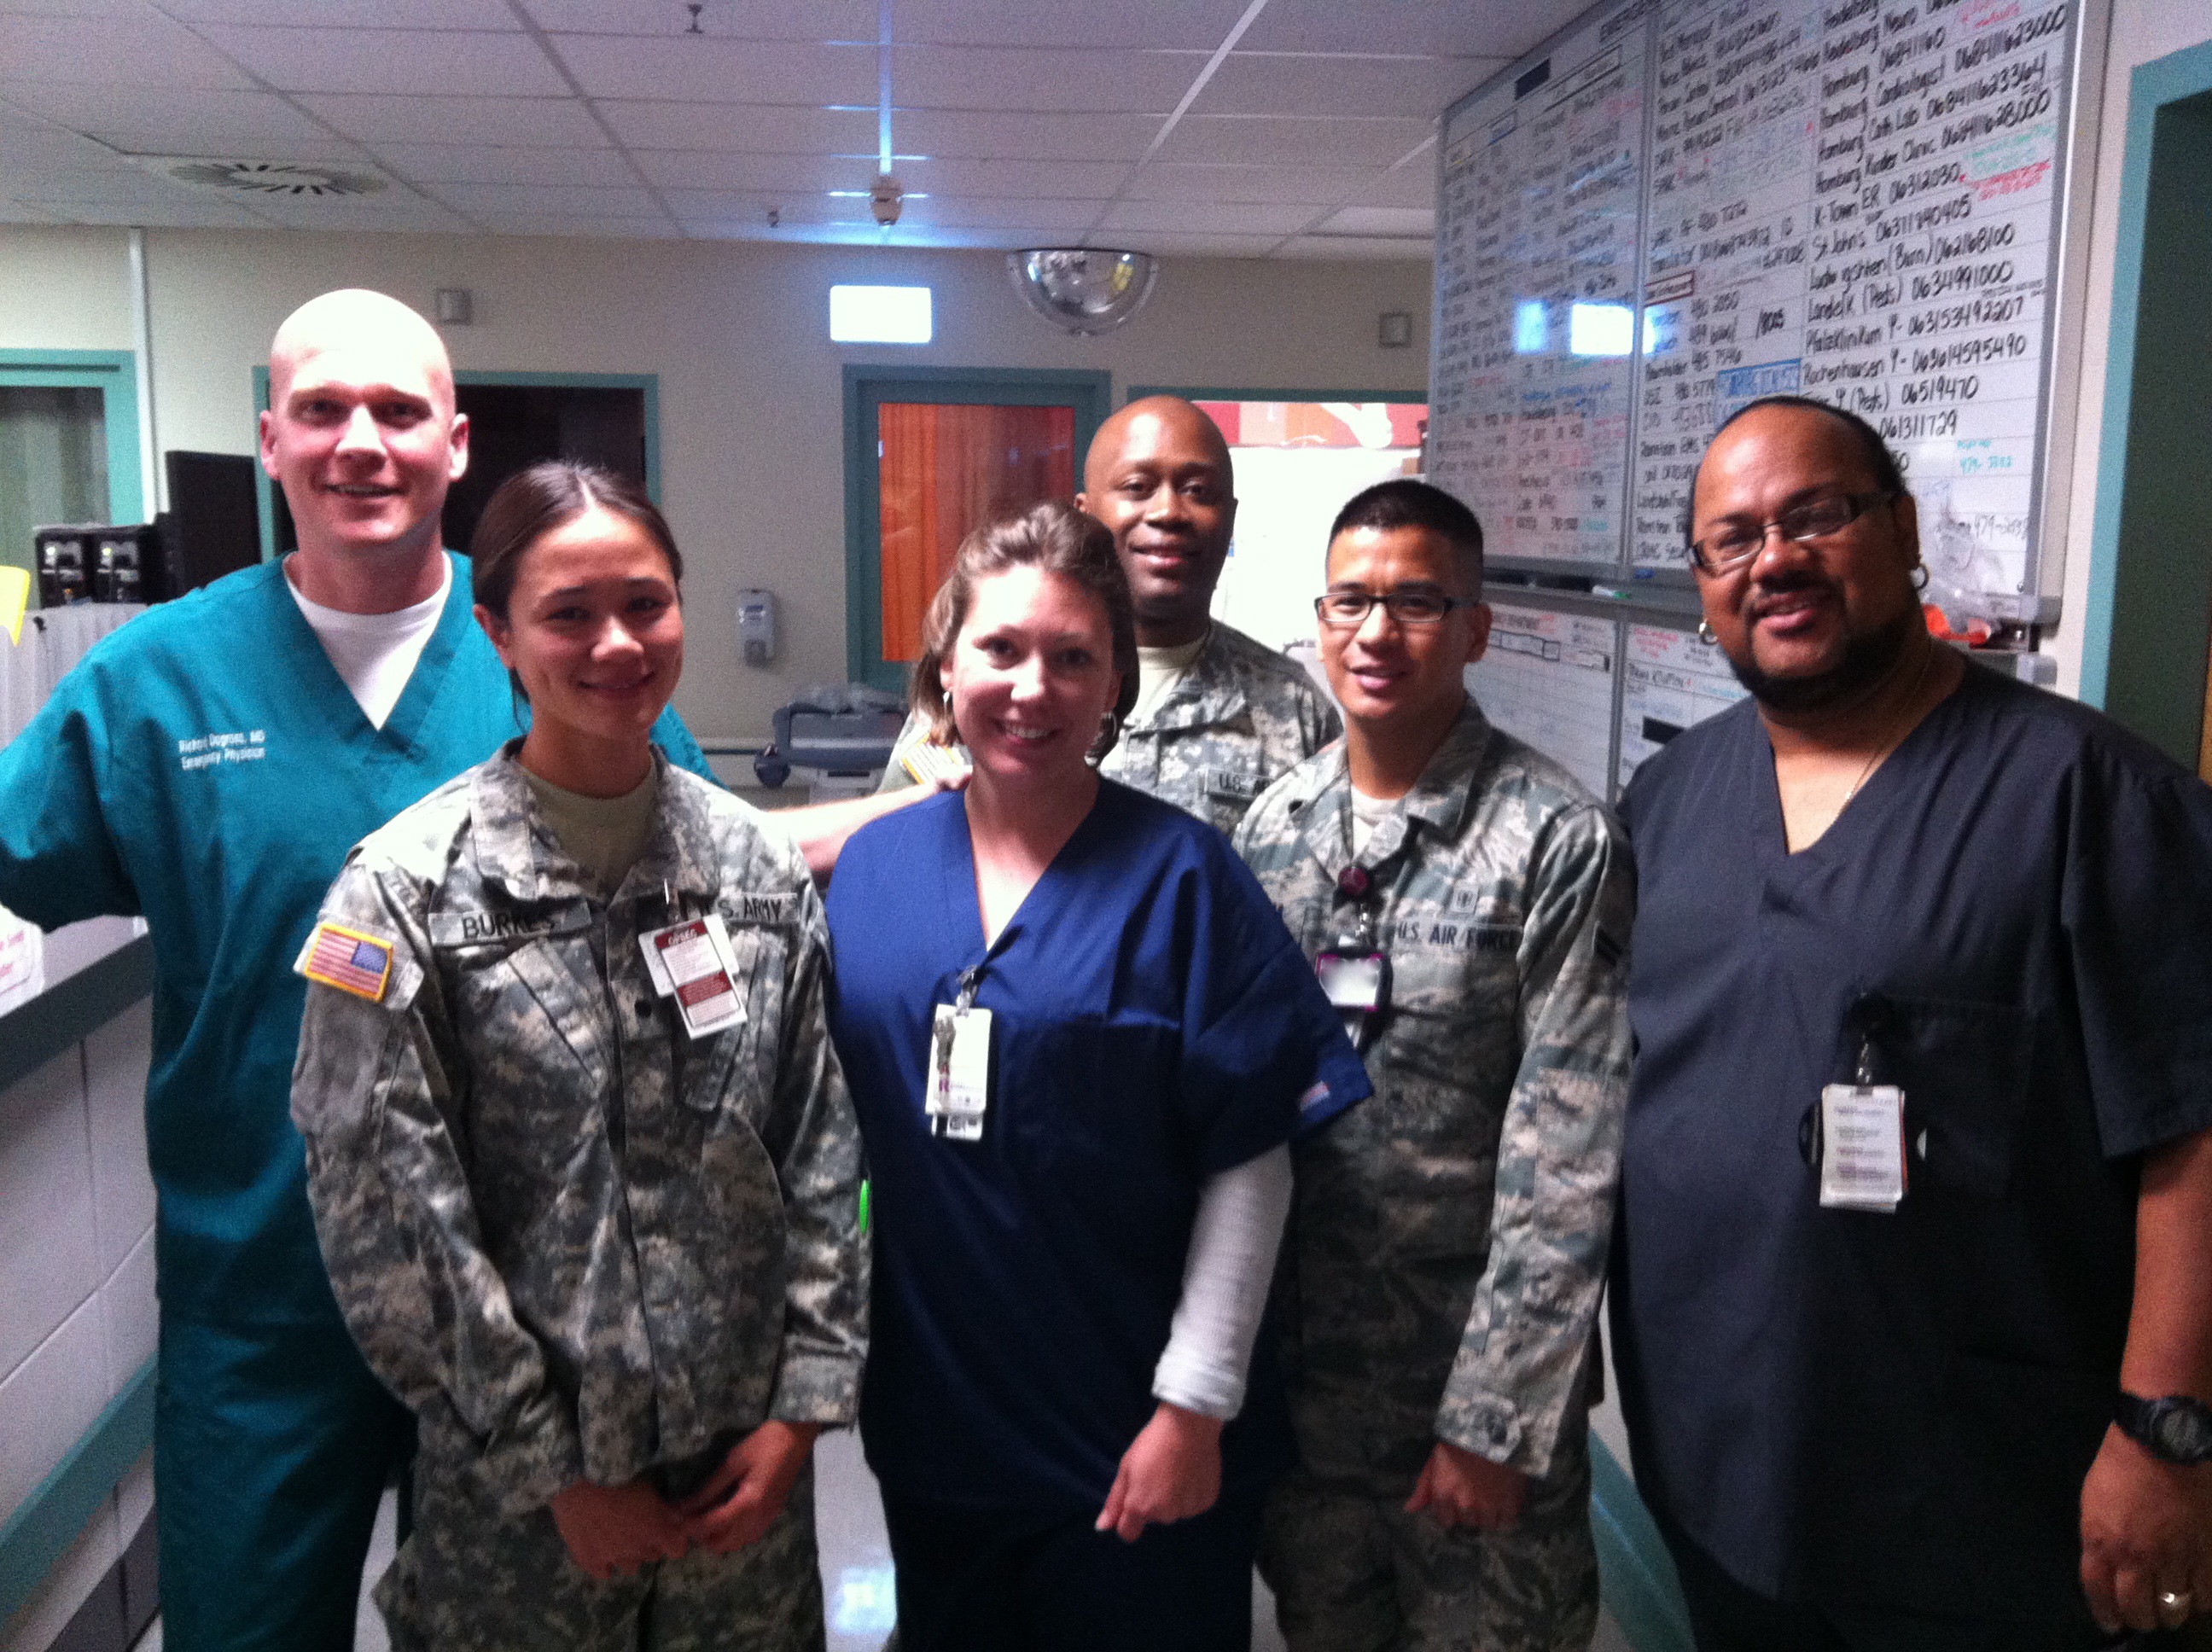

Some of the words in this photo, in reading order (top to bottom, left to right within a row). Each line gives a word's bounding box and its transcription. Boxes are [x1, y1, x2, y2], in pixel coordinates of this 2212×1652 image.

[1820, 64, 1870, 97] Homburg
[1819, 96, 1868, 133] Homburg
[1818, 133, 1865, 164] Homburg
[1815, 166, 1862, 195] Homburg
[1861, 183, 1881, 210] ER
[742, 895, 783, 922] ARMY
[1429, 923, 1458, 945] AIR
